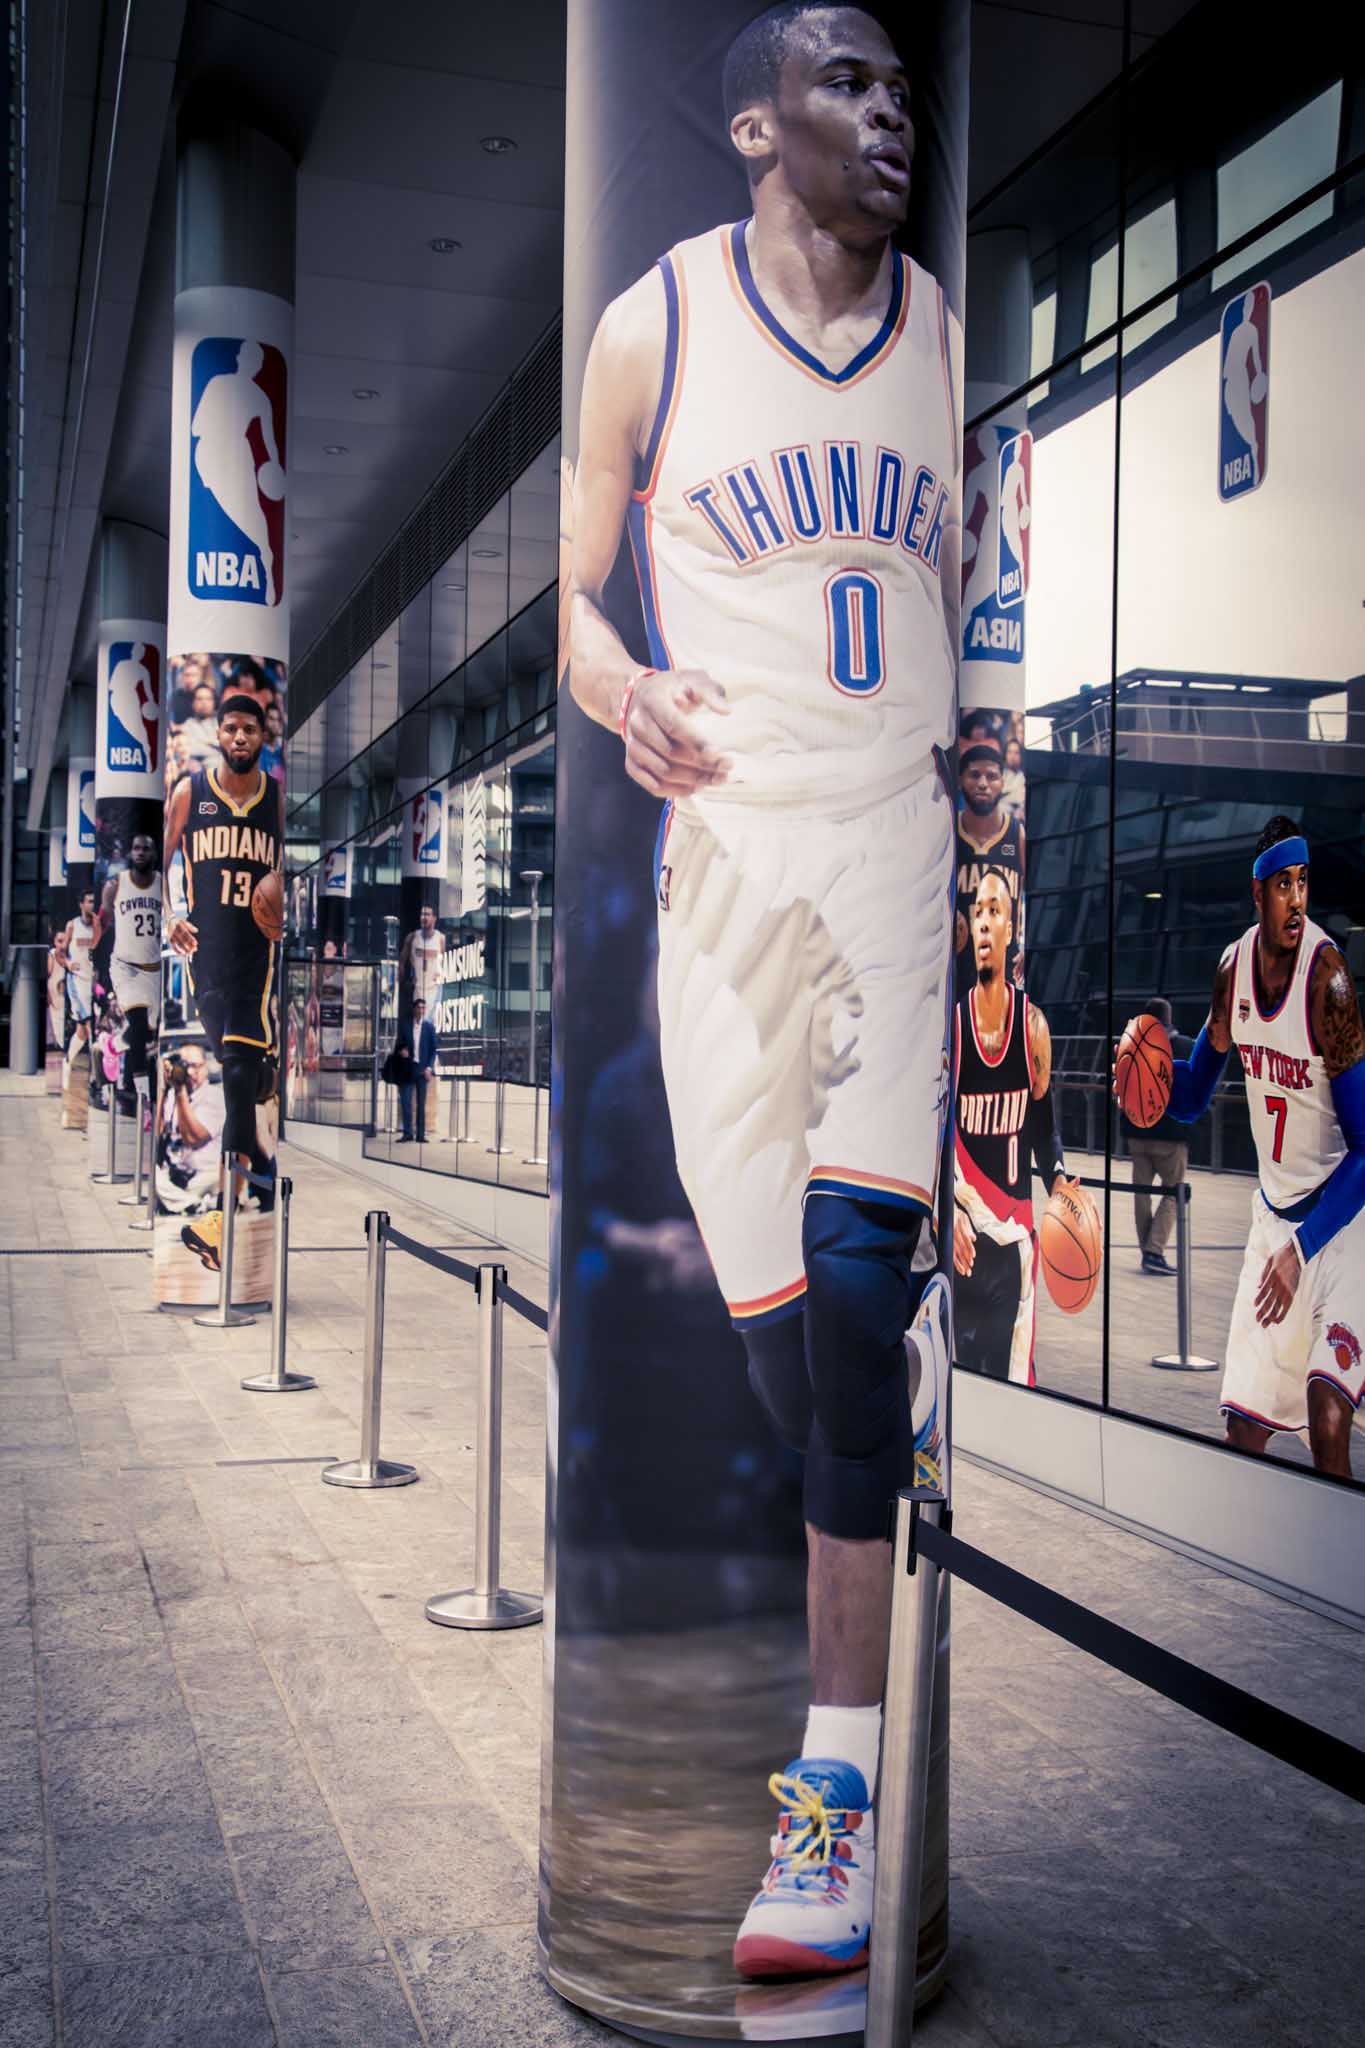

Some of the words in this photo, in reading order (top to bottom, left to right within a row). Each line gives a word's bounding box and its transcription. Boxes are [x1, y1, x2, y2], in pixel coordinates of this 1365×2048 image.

[1223, 453, 1252, 490] NBA
[196, 551, 260, 590] NBA
[1000, 569, 1021, 598] NBA
[823, 566, 888, 699] 0
[110, 747, 144, 767] NBA
[192, 825, 275, 869] INDIANA
[220, 868, 253, 908] 13
[134, 914, 155, 937] 23
[435, 940, 486, 986] SAMSUNG
[434, 994, 485, 1034] DISTRICT
[1262, 1047, 1314, 1091] YORK
[1264, 1094, 1288, 1164] 7
[1007, 1134, 1019, 1186] 0
